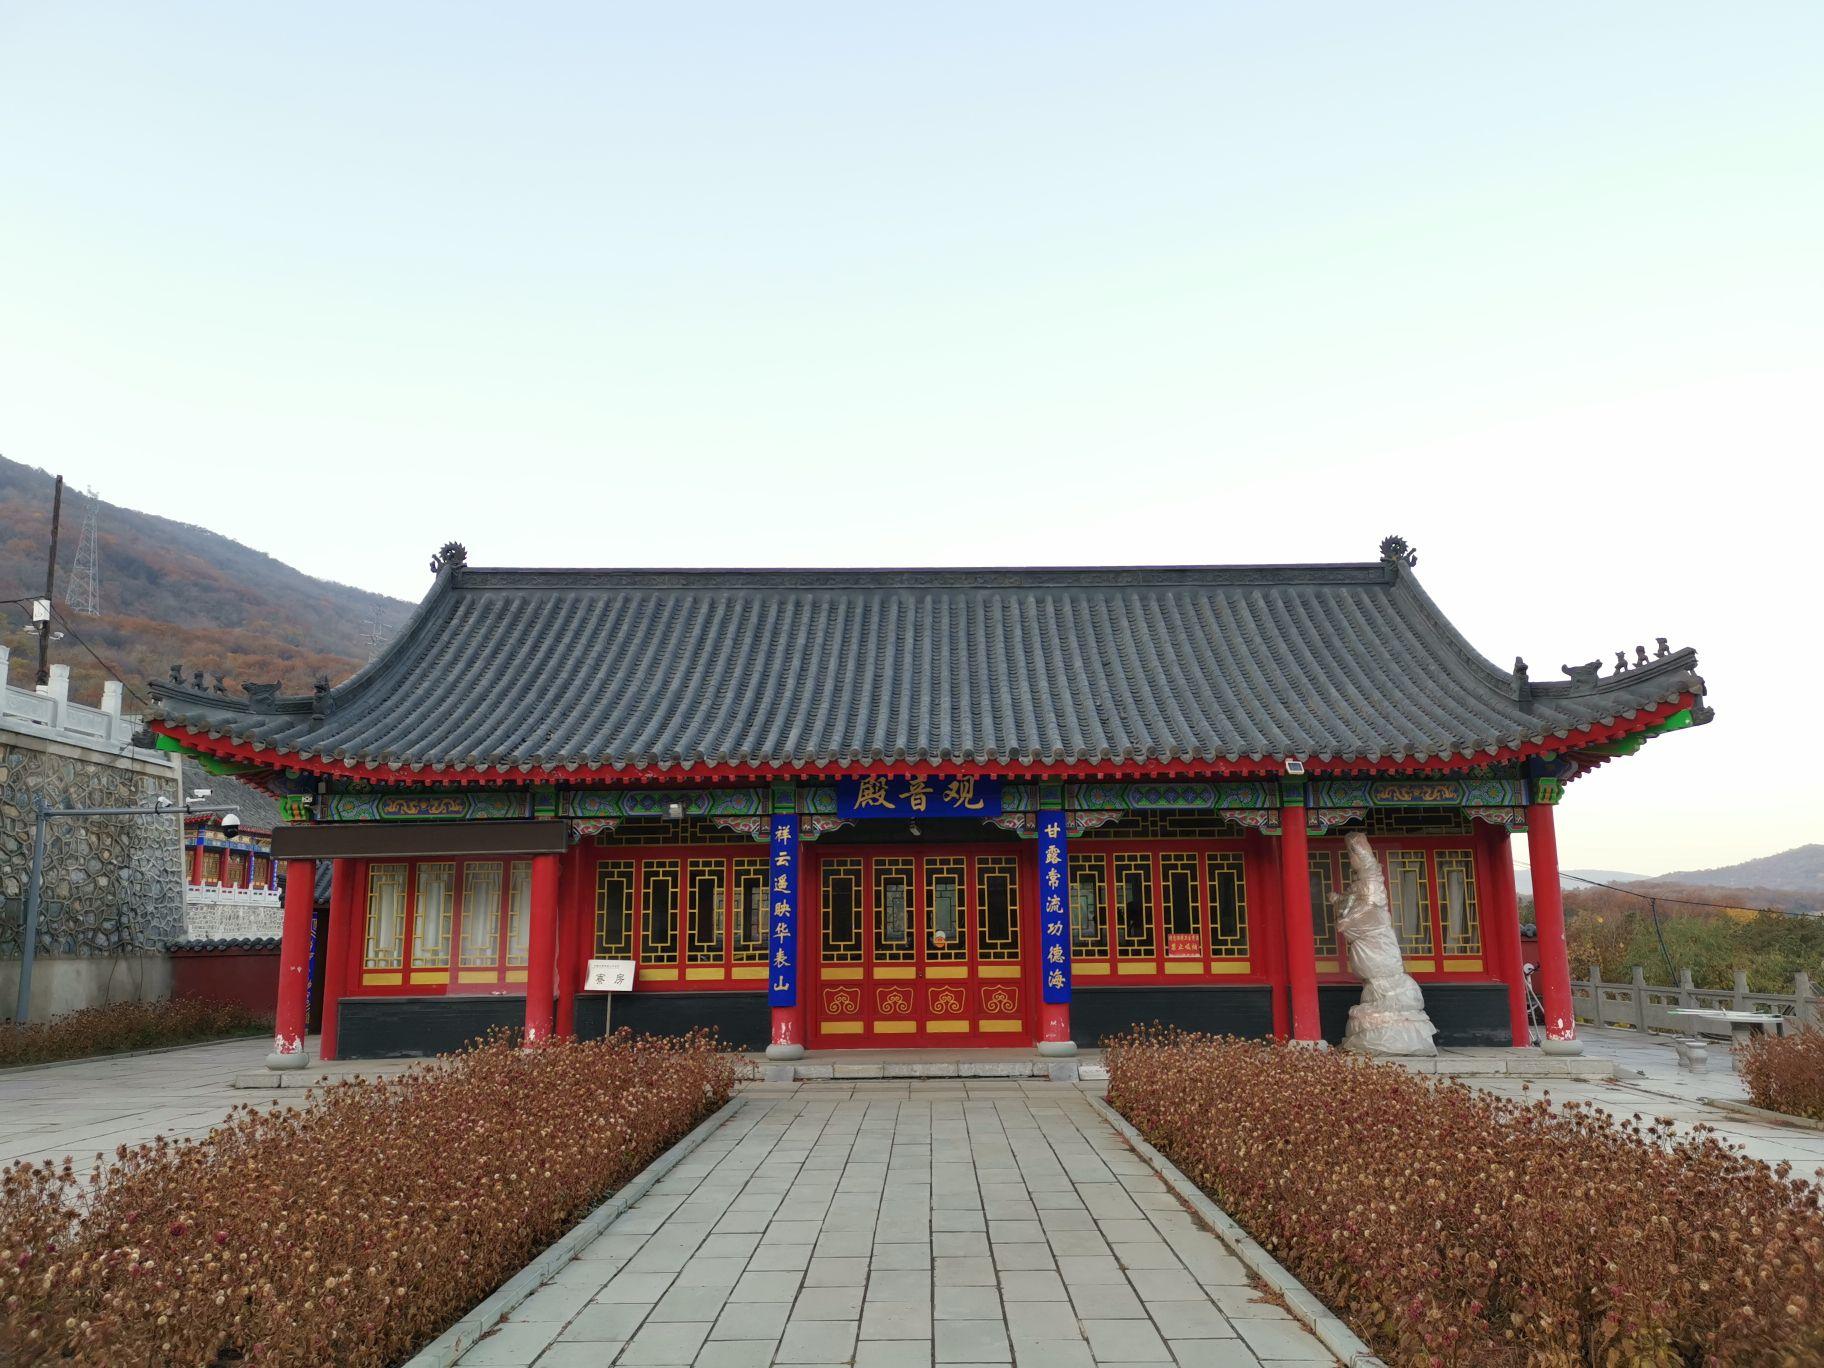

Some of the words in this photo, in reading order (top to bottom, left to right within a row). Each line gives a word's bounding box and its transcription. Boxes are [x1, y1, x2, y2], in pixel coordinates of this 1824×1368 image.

[772, 824, 792, 991] 祥云遥映华表山
[1044, 822, 1066, 989] 甘露常流功德海
